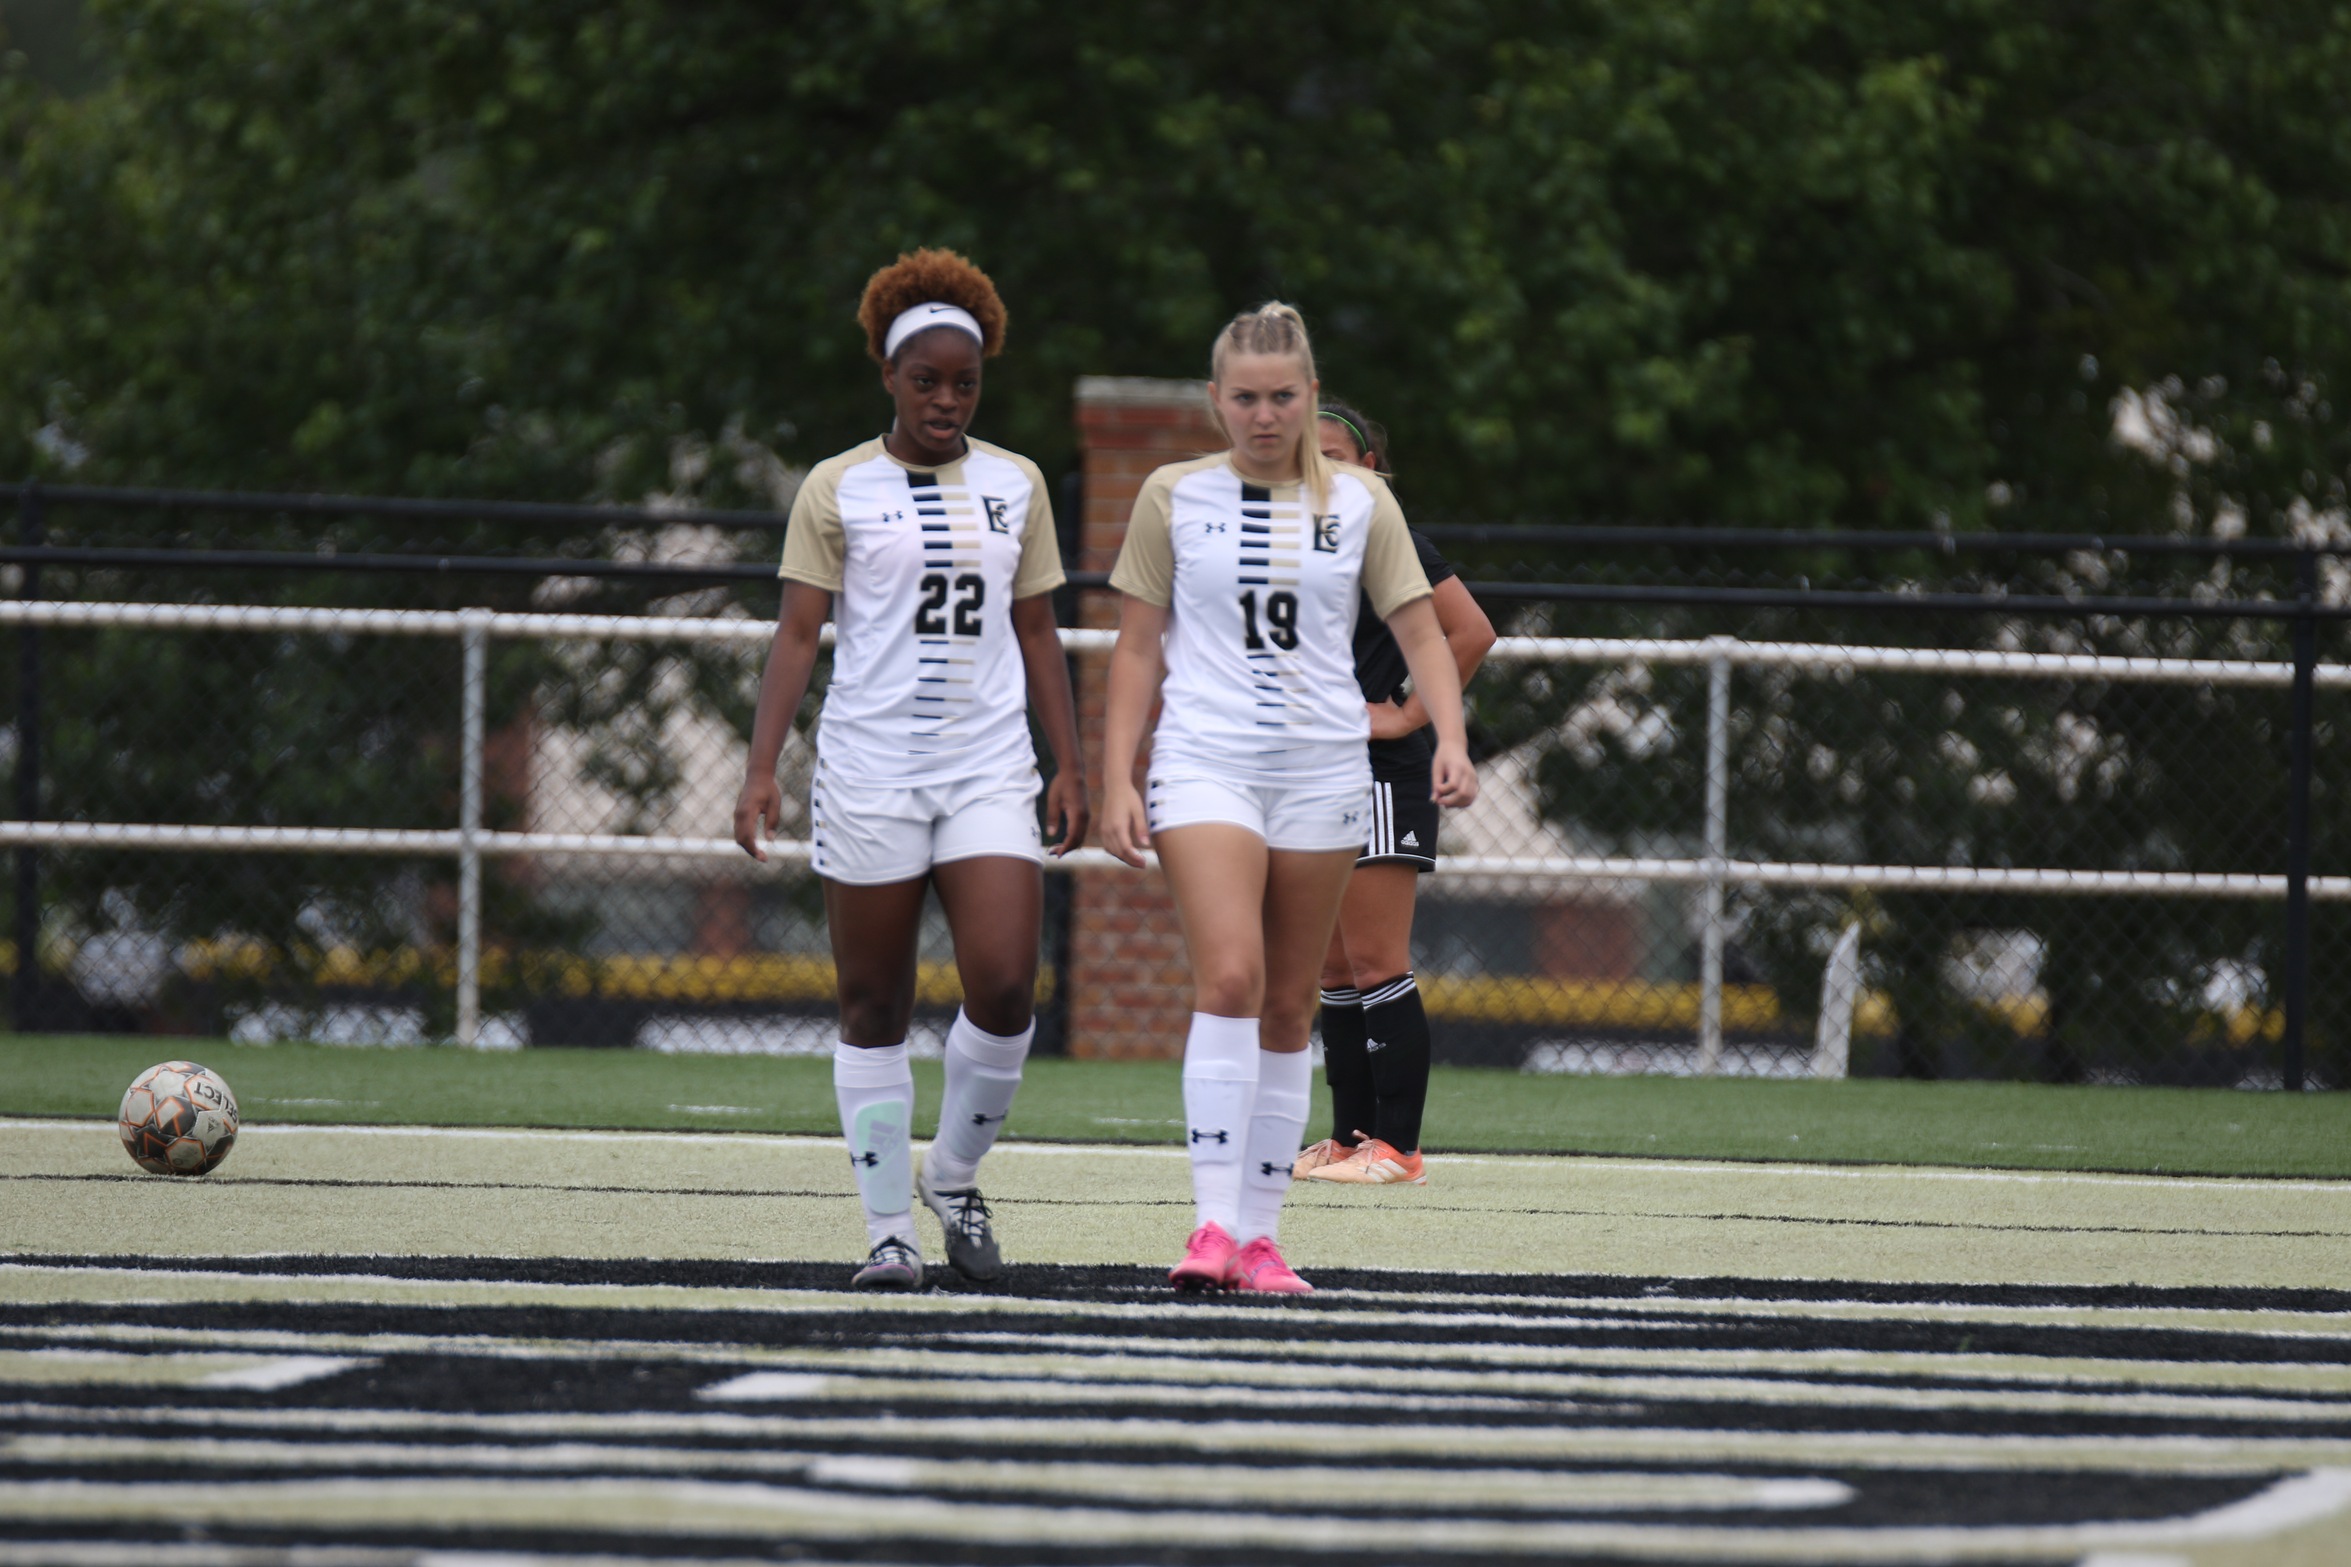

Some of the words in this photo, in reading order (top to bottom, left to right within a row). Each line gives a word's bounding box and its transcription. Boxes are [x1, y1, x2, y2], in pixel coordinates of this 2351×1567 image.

[915, 572, 985, 636] 22
[1239, 590, 1299, 651] 19
[194, 1081, 238, 1124] SELECT
